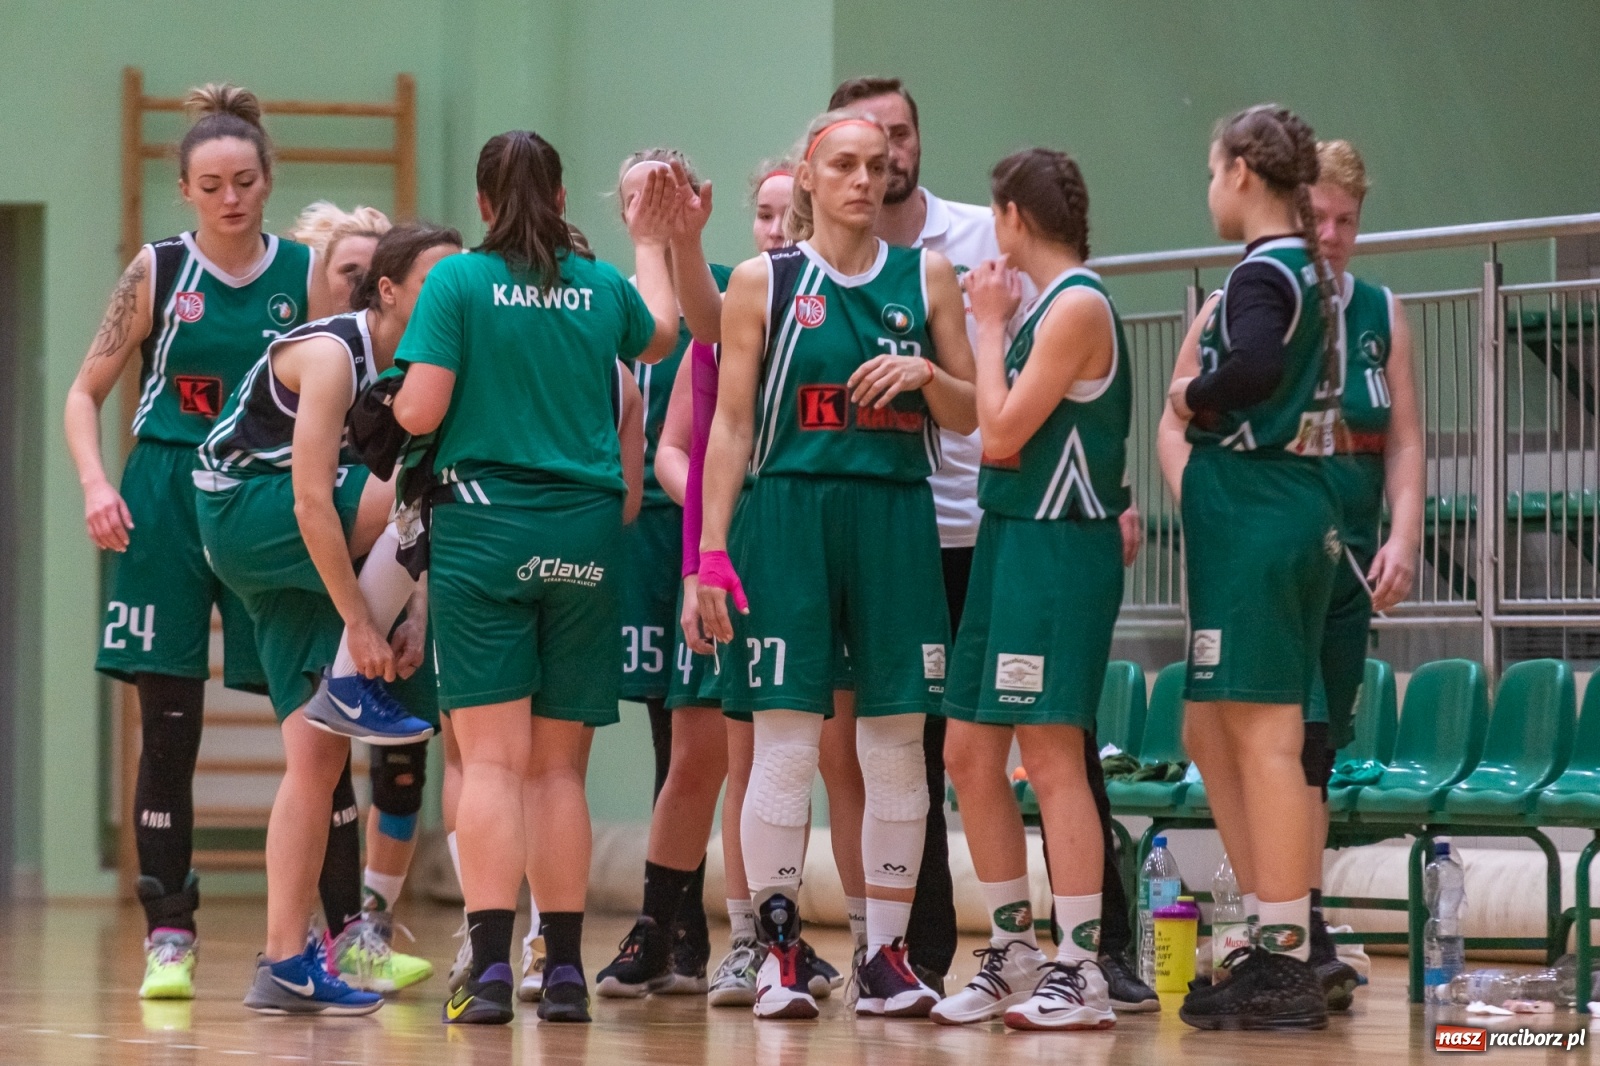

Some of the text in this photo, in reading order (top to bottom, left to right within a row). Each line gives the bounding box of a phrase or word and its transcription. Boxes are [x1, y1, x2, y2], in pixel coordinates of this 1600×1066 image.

[492, 283, 593, 311] KARWOT
[804, 390, 842, 425] K
[540, 557, 604, 581] Clavis
[104, 601, 156, 651] 24
[622, 626, 665, 673] 35
[746, 637, 787, 688] 27
[149, 811, 172, 829] NBA
